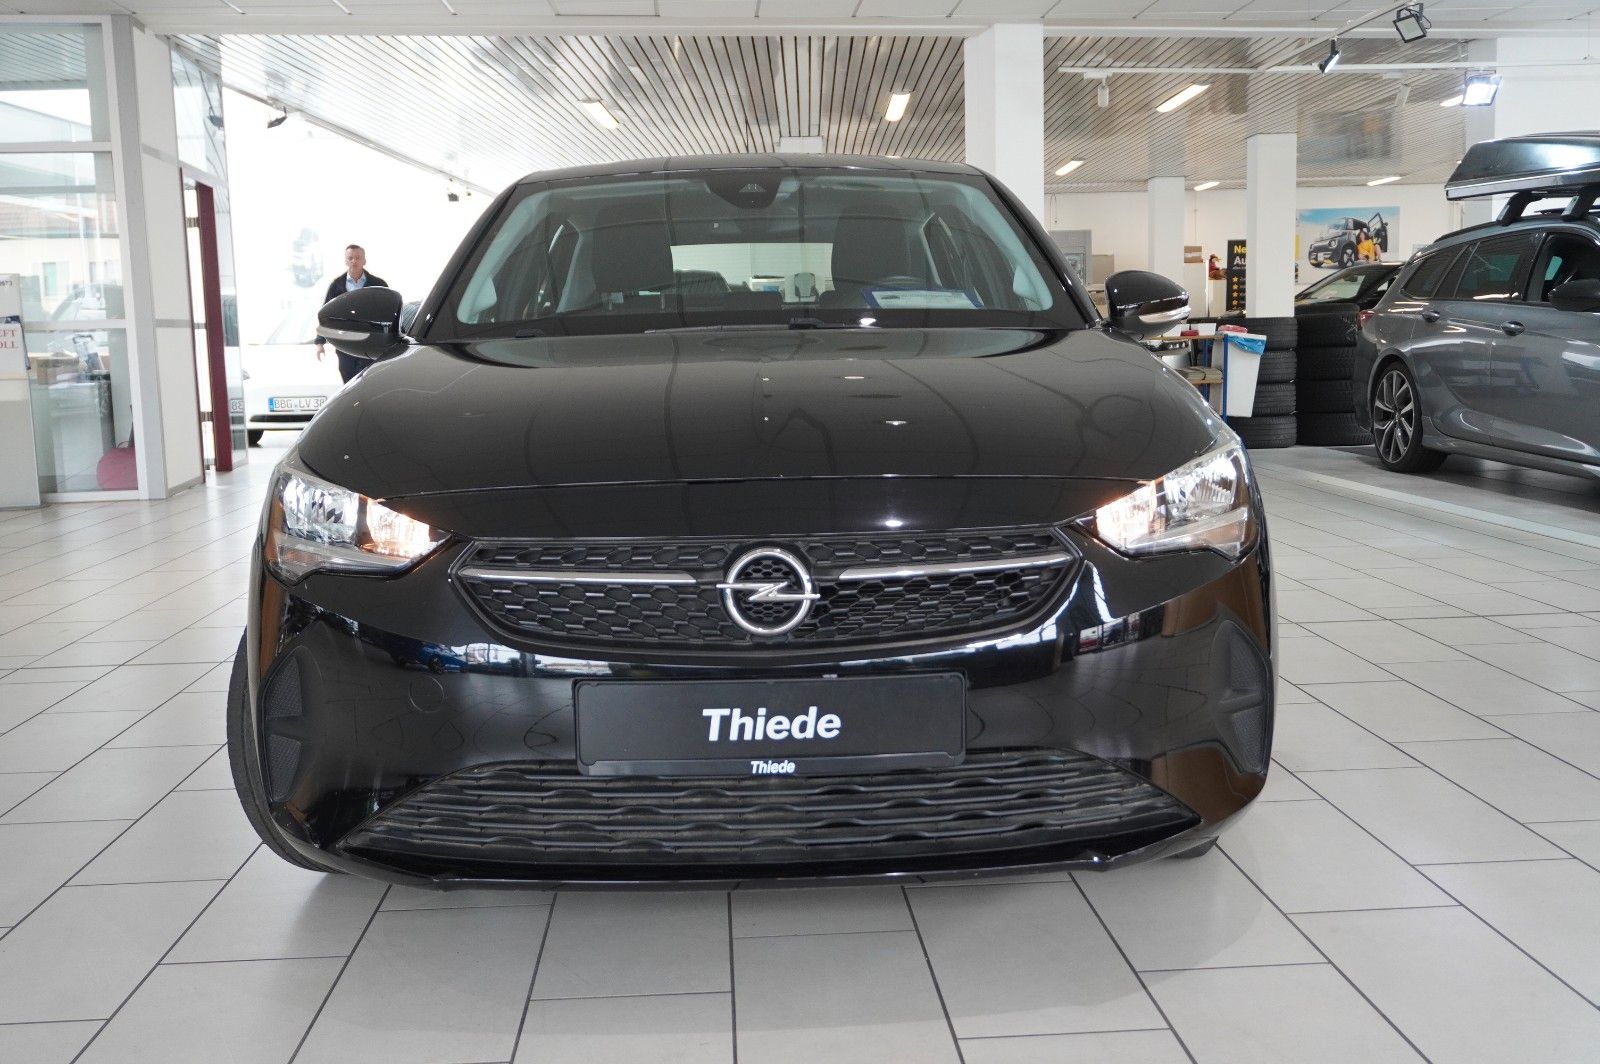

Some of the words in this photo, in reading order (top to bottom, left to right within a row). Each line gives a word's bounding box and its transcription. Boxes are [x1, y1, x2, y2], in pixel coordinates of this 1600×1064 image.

[274, 399, 293, 409] BBG
[298, 399, 311, 409] LV
[702, 705, 842, 742] Thiede
[750, 759, 796, 775] Thiede
